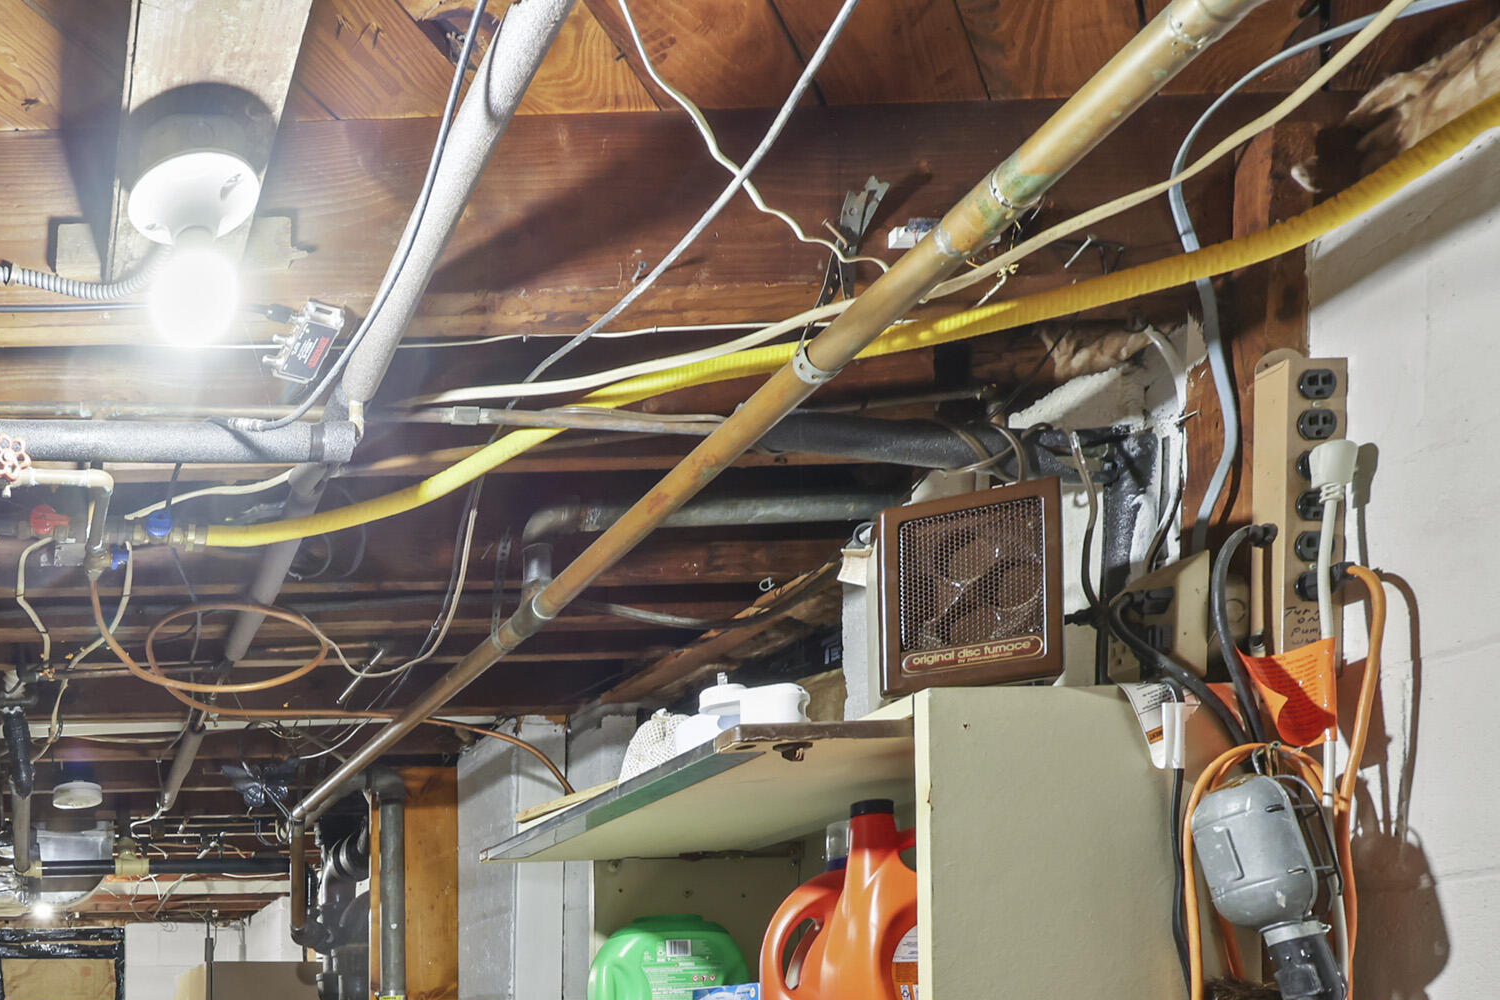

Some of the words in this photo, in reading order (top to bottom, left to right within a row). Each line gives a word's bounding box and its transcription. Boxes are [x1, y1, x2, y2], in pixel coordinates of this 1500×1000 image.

[912, 650, 955, 665] original
[957, 647, 981, 658] disc
[984, 641, 1031, 654] furnace
